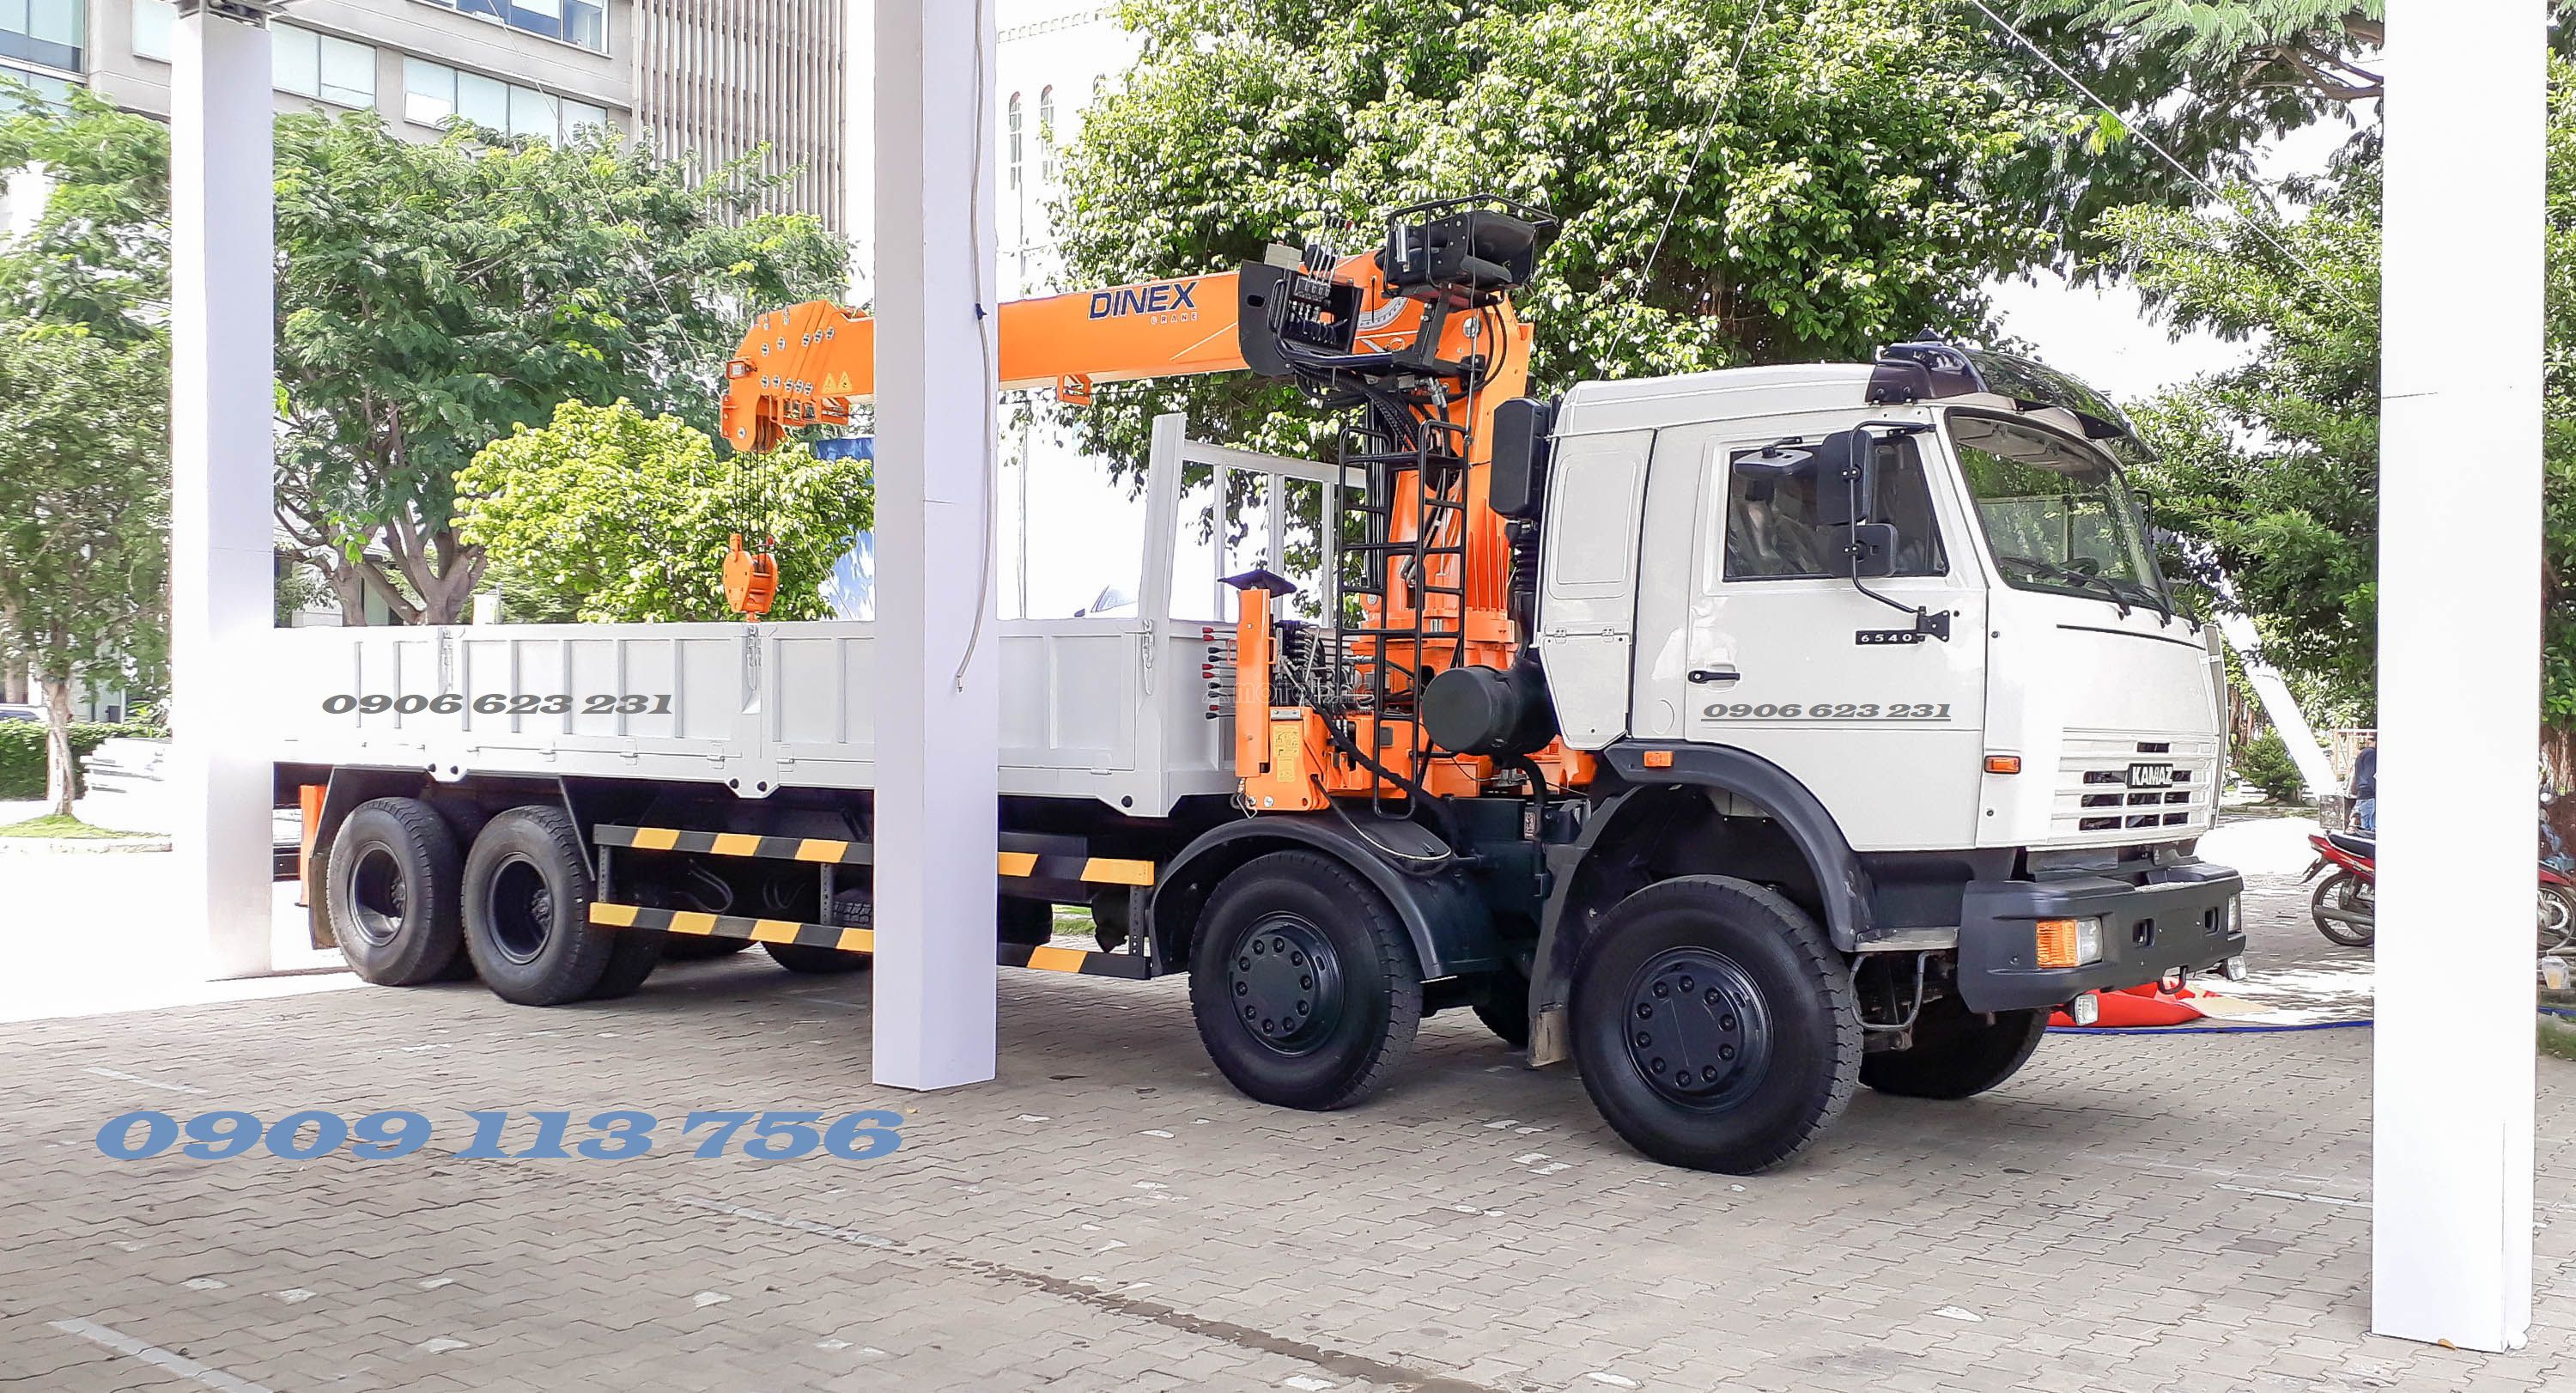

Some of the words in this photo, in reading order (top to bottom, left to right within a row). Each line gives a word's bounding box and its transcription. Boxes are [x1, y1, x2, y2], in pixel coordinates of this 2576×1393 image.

[1088, 280, 1200, 320] DINEX
[1150, 312, 1198, 325] CRANE
[1861, 633, 1912, 642] 6540
[2131, 765, 2174, 786] KAMAZ
